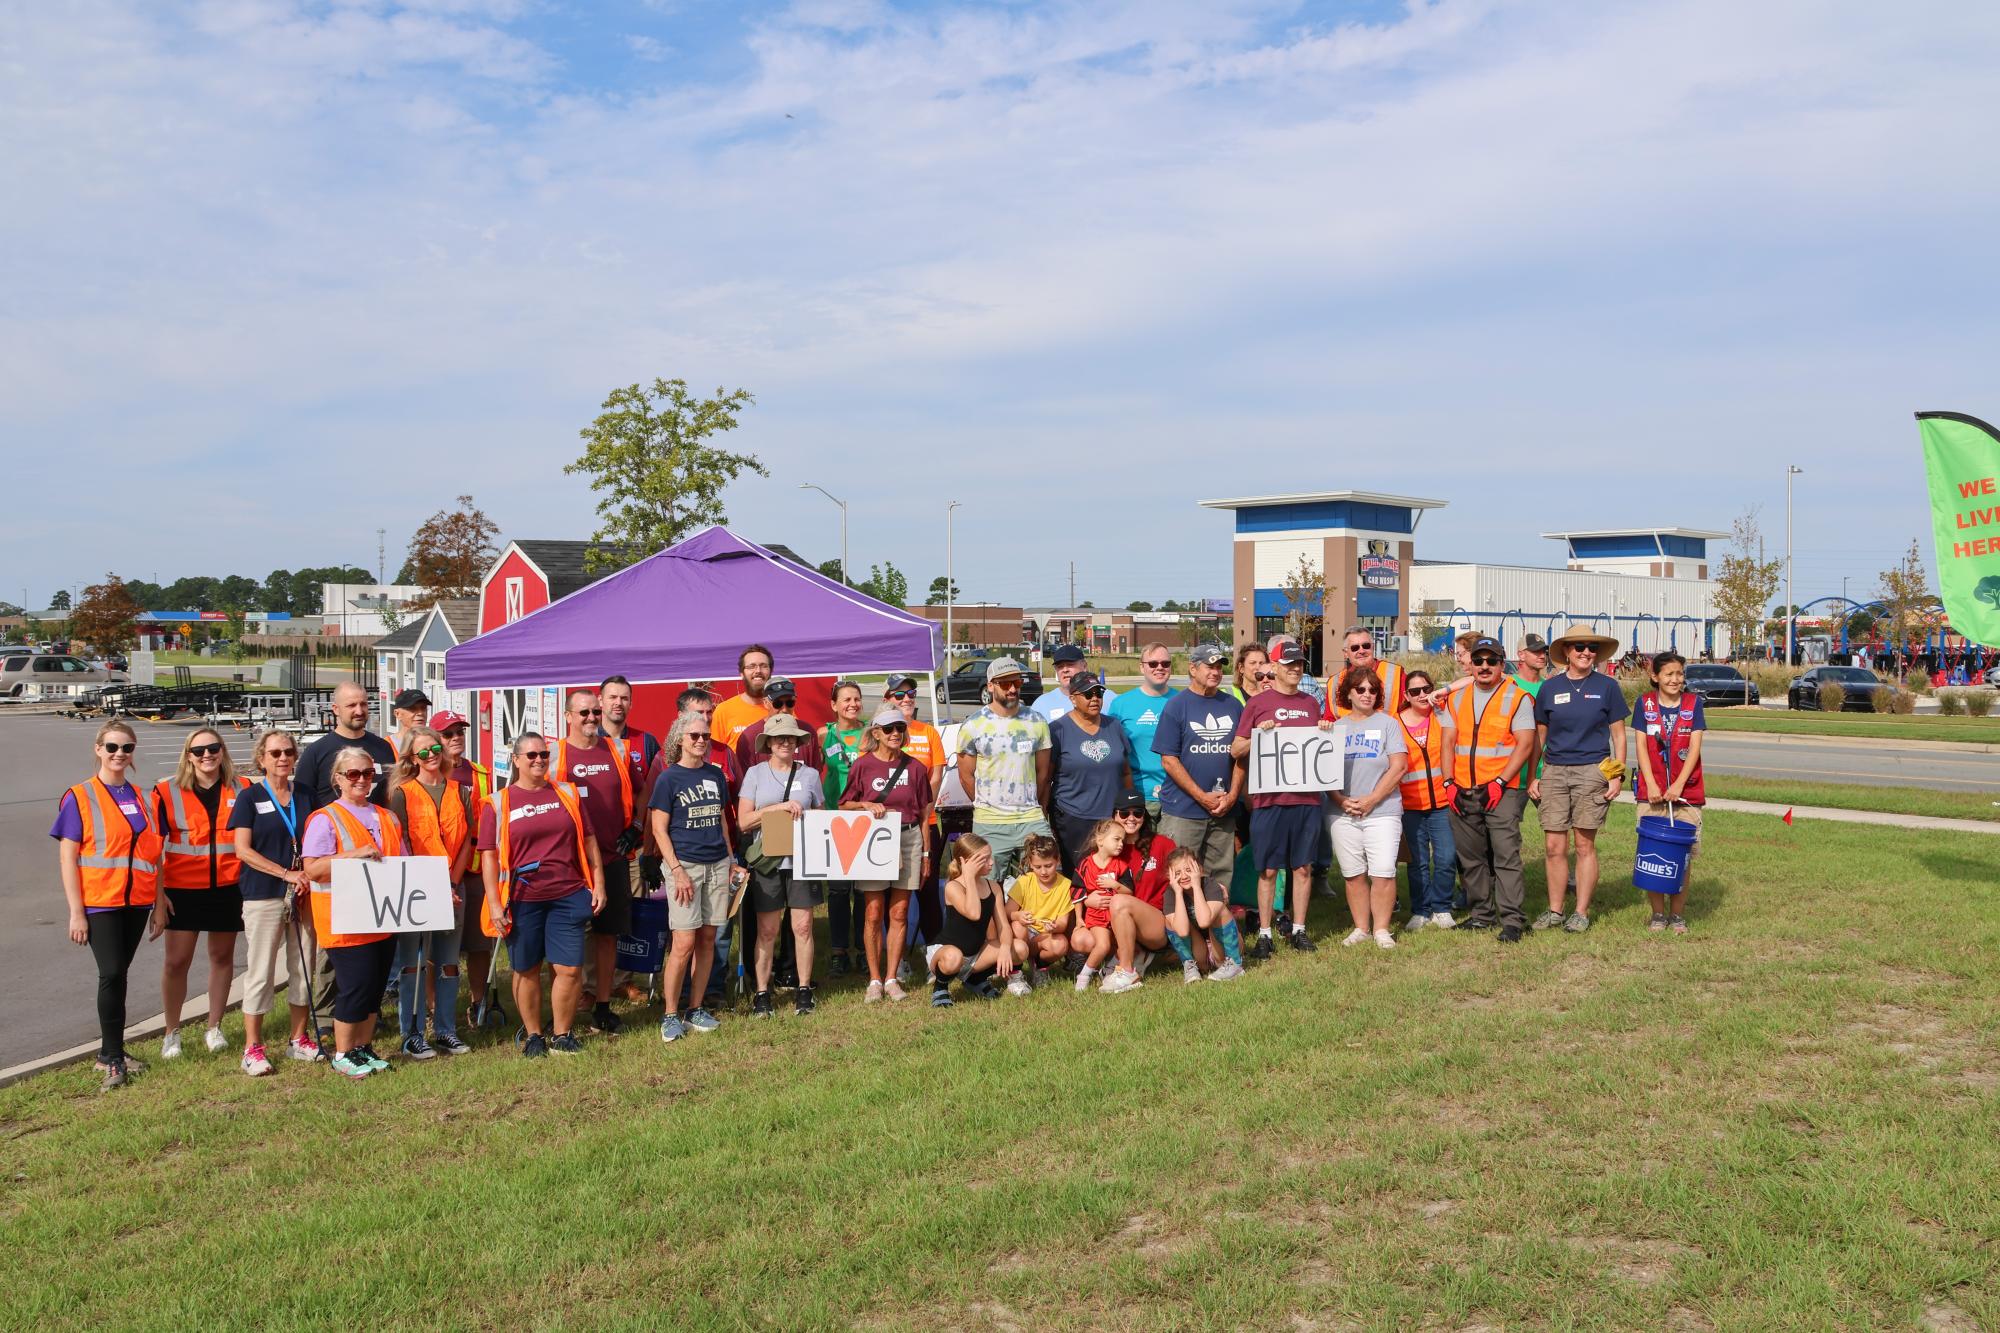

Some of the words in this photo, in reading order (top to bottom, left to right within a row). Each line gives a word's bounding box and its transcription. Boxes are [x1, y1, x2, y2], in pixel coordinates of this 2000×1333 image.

[1958, 478, 1996, 498] WE
[1367, 576, 1379, 585] CAR
[1288, 710, 1309, 718] SERVE
[1190, 742, 1232, 753] adidas
[1257, 731, 1338, 789] Here
[536, 802, 560, 811] SERVE
[1637, 857, 1673, 876] LOWE'S
[362, 861, 428, 928] We
[616, 940, 645, 954] OWE'S
